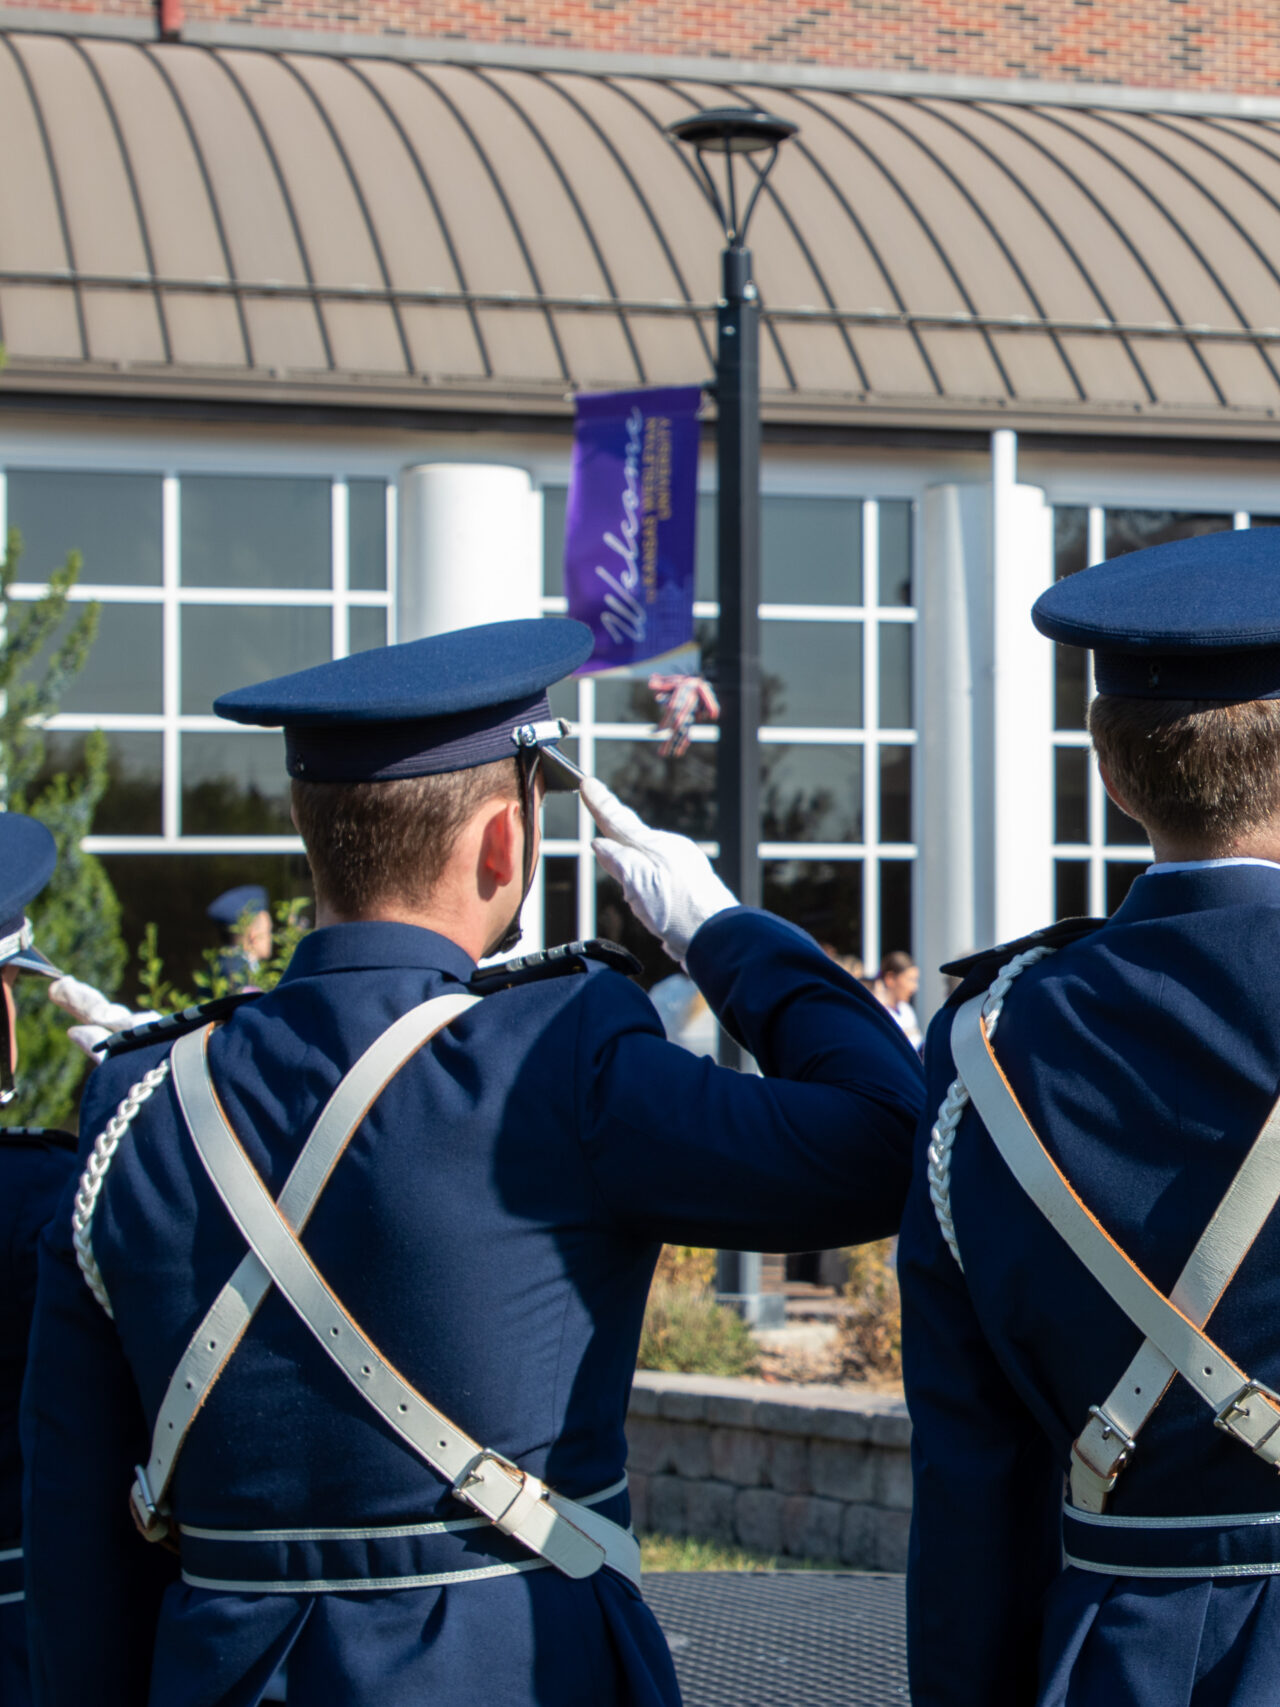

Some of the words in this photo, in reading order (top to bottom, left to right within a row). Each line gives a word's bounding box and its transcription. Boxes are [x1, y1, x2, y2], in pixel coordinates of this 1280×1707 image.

[642, 416, 657, 511] WESLEYAN
[657, 416, 672, 521] UNIVERSITY
[595, 406, 647, 643] Welcome
[642, 515, 657, 587] KANSAS
